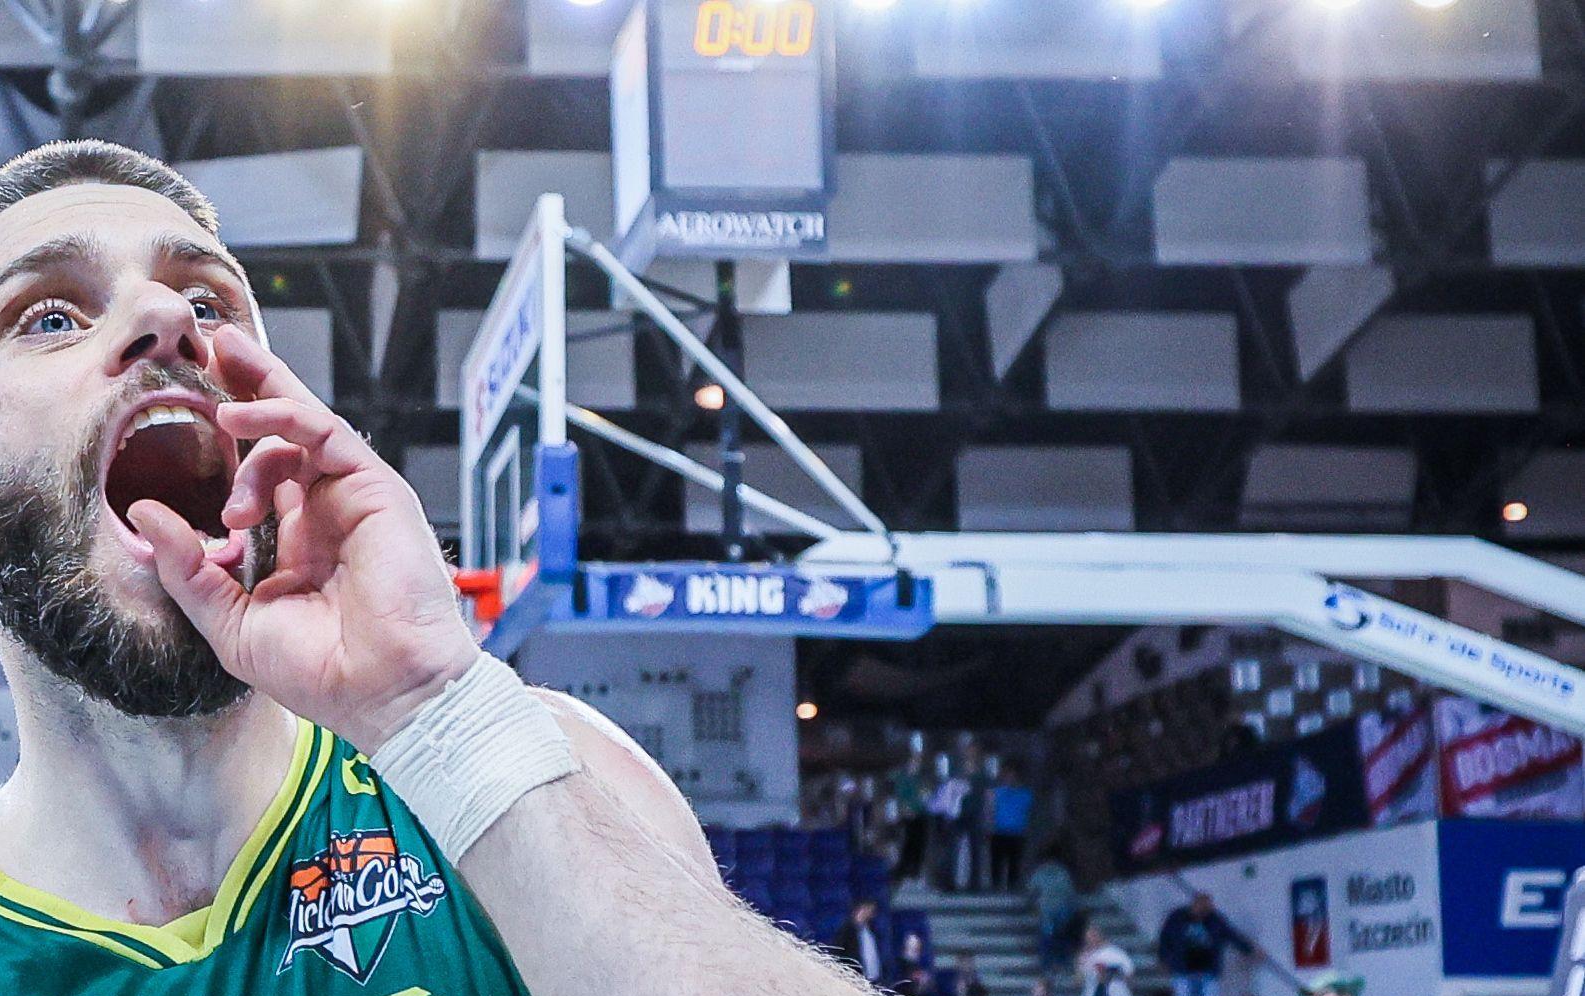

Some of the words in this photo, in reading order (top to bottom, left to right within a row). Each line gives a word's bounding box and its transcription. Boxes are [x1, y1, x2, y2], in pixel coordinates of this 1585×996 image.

[695, 1, 813, 56] 0:00
[686, 575, 784, 614] KING
[1346, 873, 1415, 905] Miasto
